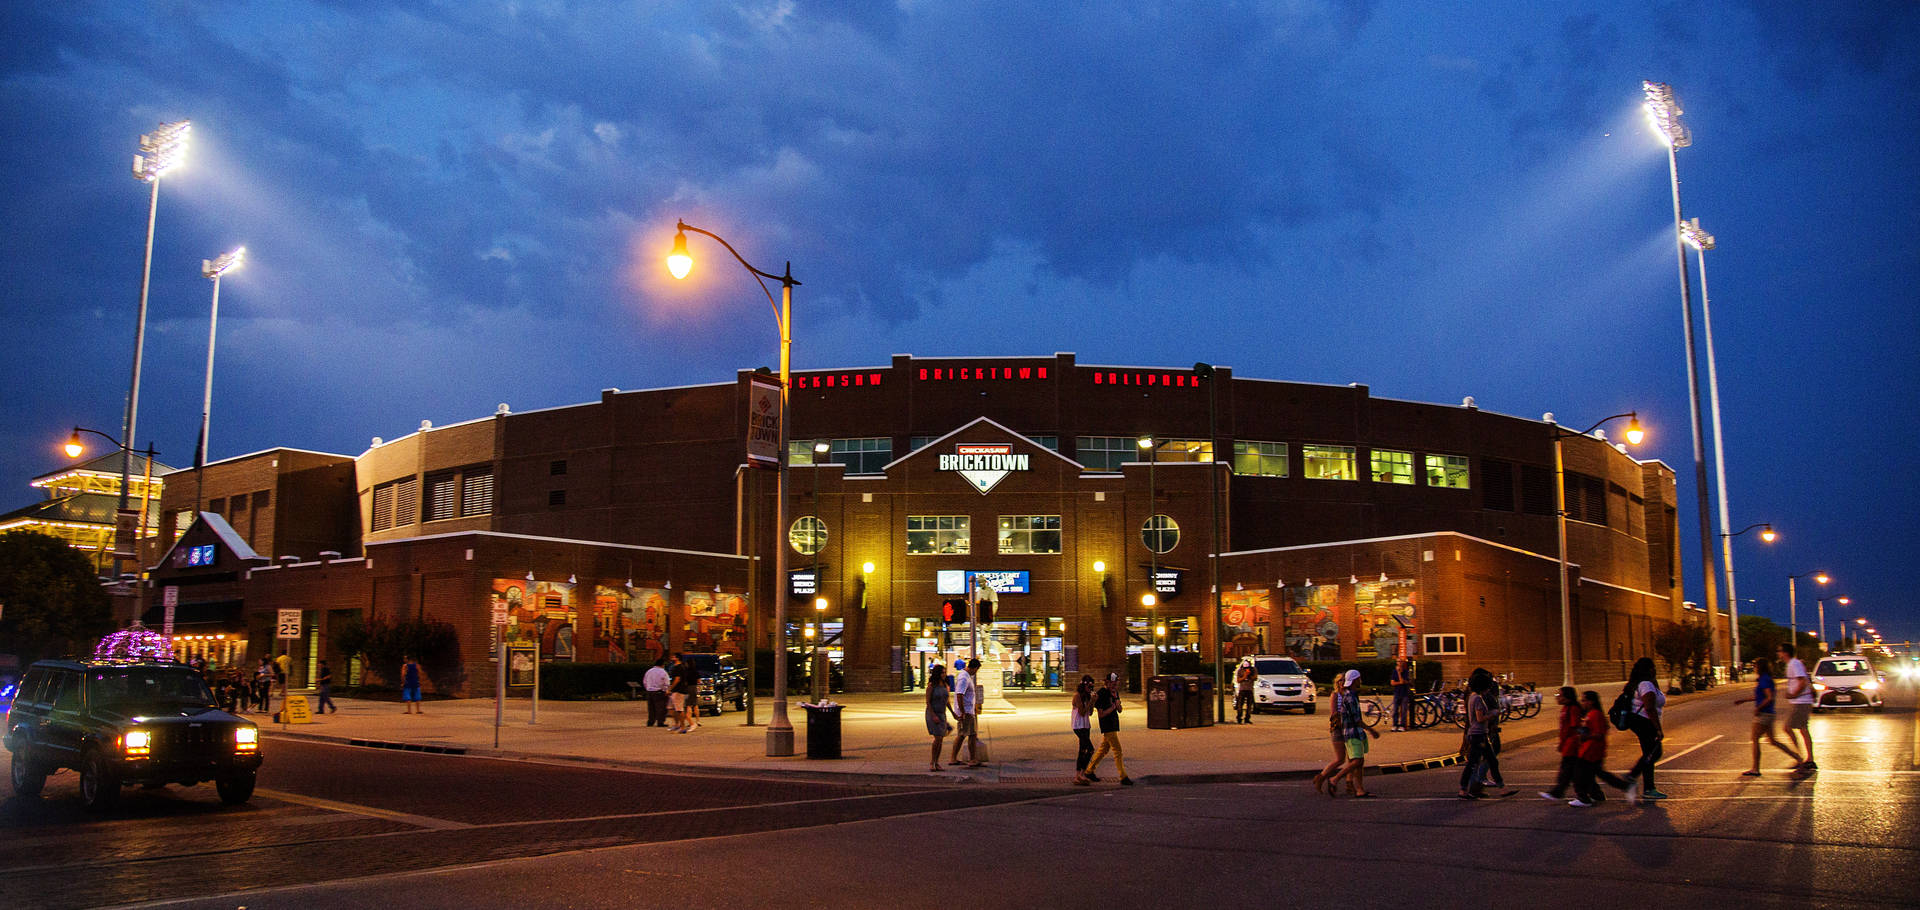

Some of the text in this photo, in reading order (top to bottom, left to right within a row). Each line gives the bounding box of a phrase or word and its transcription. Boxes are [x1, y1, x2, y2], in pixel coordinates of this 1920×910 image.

[788, 367, 1200, 388] ICKASAW BRICKTOWN BALLPARK
[939, 454, 1029, 471] BRICKTOWN
[280, 624, 300, 635] 25
